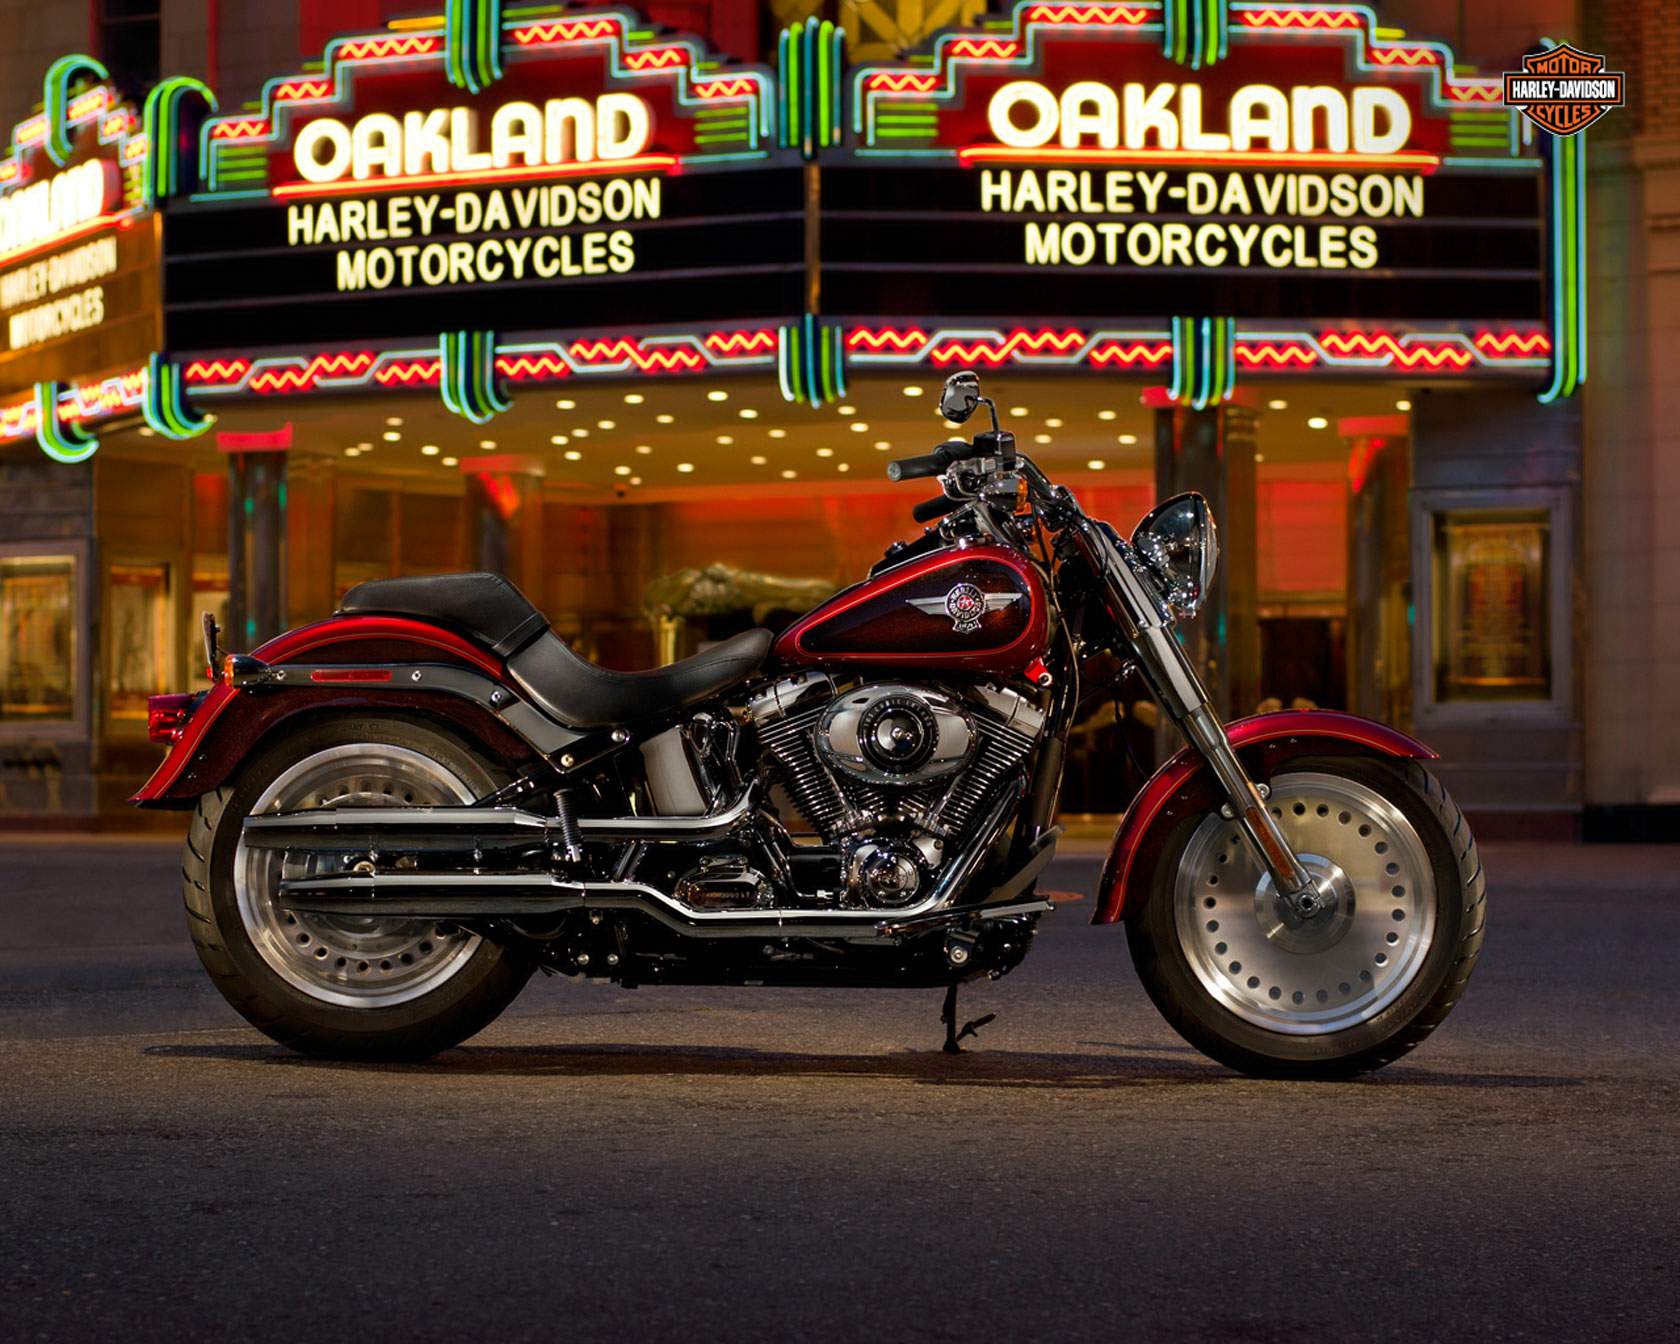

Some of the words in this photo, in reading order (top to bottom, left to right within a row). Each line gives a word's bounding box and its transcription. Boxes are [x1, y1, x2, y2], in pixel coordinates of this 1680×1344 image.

[293, 93, 651, 184] OAKLAND
[987, 81, 1412, 155] OAKLAND
[287, 177, 661, 246] HARLEY-DAVIDSON
[980, 169, 1424, 217] HARLEY-DAVIDSON
[336, 230, 636, 291] MOTORCYCLES
[1024, 222, 1379, 269] MOTORCYCLES
